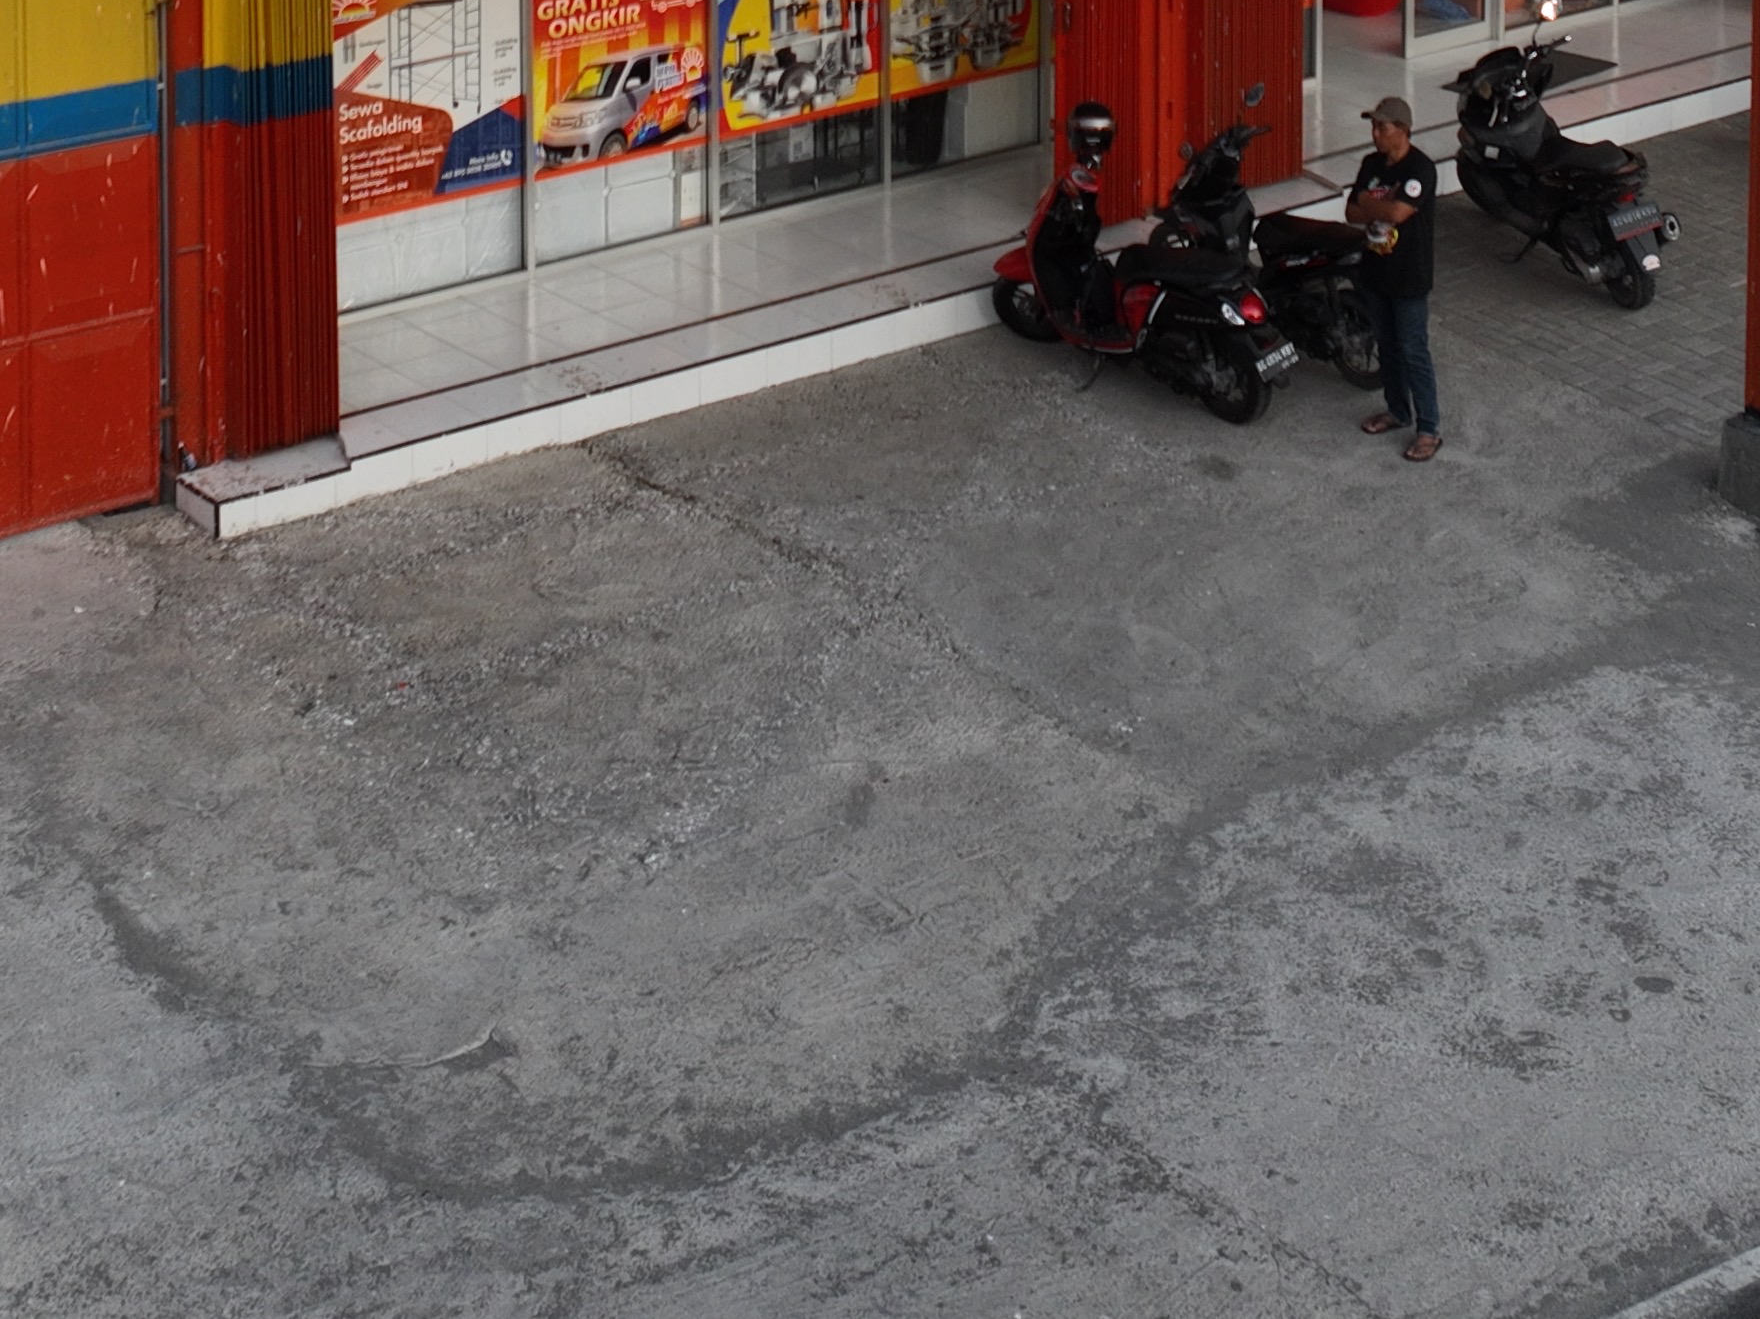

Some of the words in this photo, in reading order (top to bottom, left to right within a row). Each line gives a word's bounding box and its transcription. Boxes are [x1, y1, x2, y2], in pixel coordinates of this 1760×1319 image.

[548, 3, 642, 39] ONGKIR
[339, 101, 384, 122] Sewa
[339, 115, 423, 145] Scafolding
